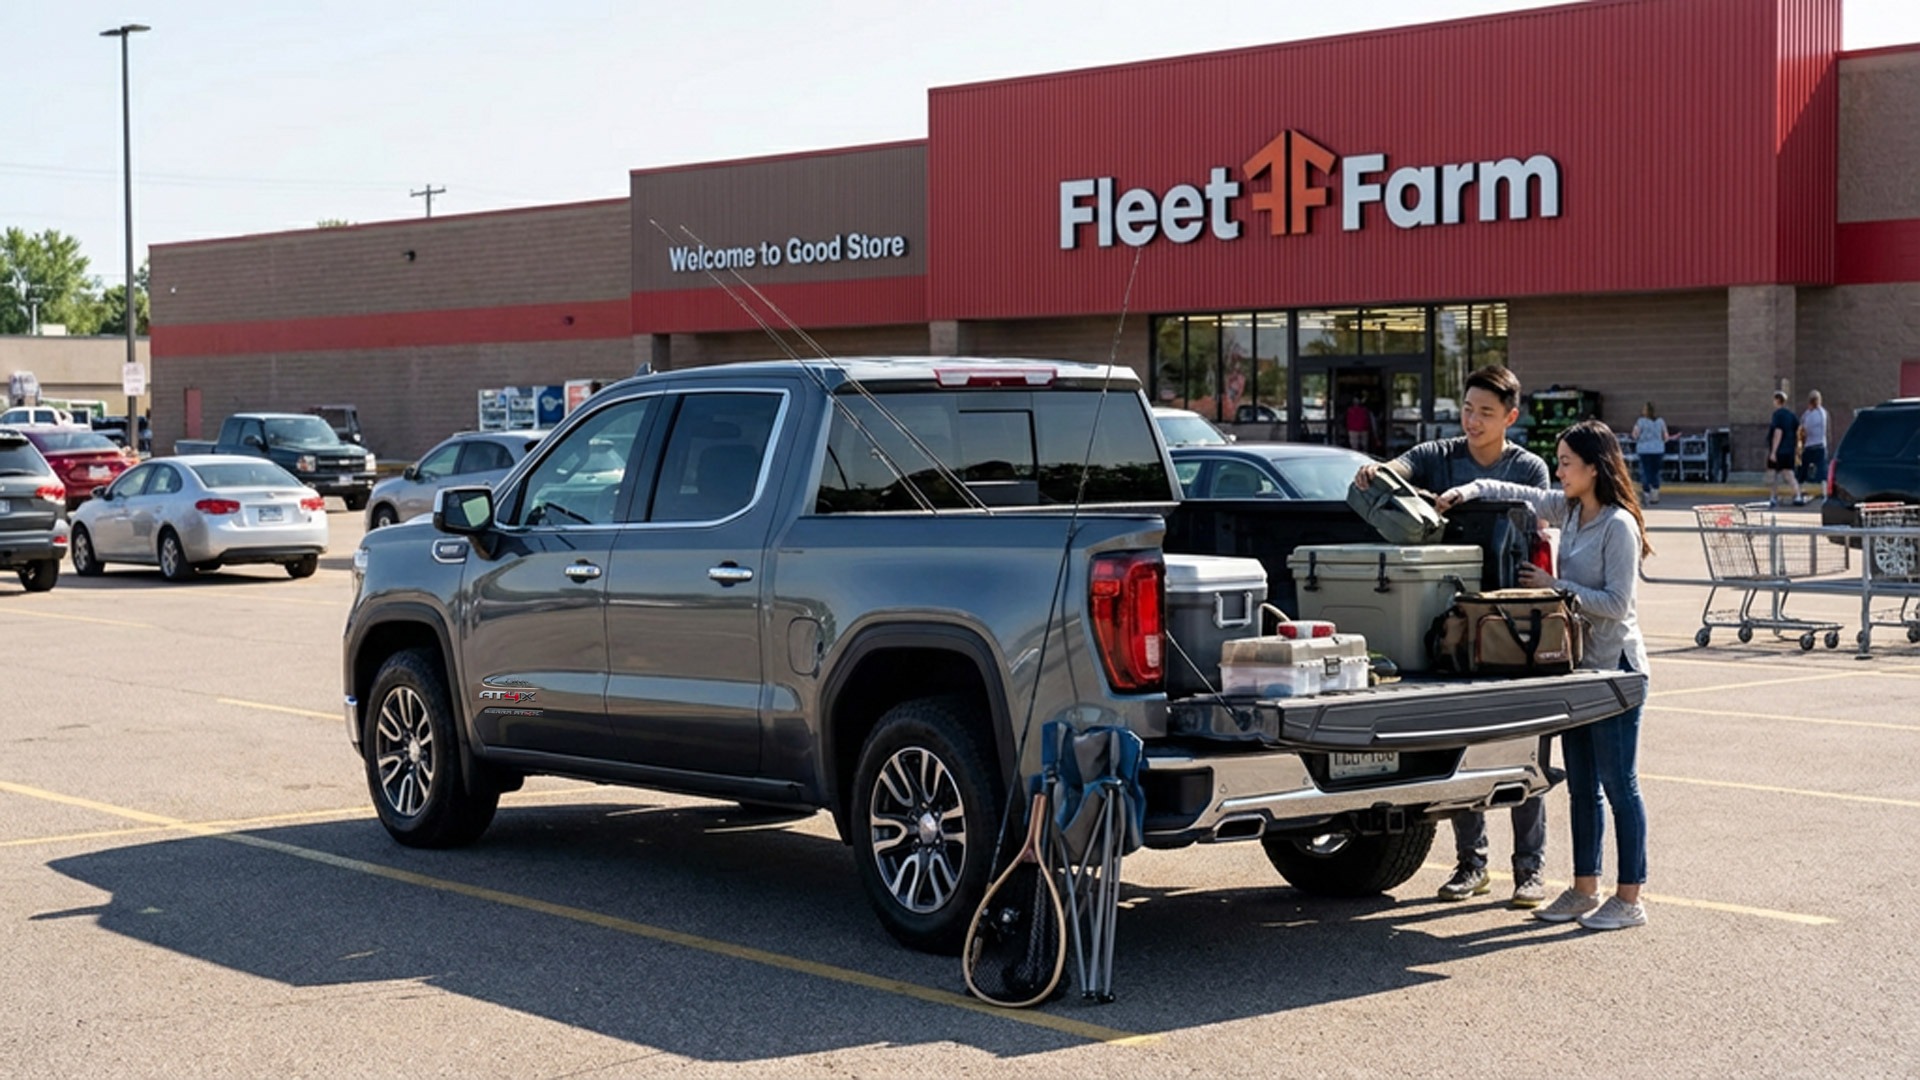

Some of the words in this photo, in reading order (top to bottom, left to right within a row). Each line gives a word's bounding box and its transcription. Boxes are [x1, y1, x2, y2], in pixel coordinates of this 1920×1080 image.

[1060, 167, 1240, 249] Fleet
[1342, 153, 1560, 232] Farm
[669, 244, 756, 272] Welcome
[760, 241, 781, 266] to
[786, 234, 842, 264] Good
[847, 232, 905, 260] Store
